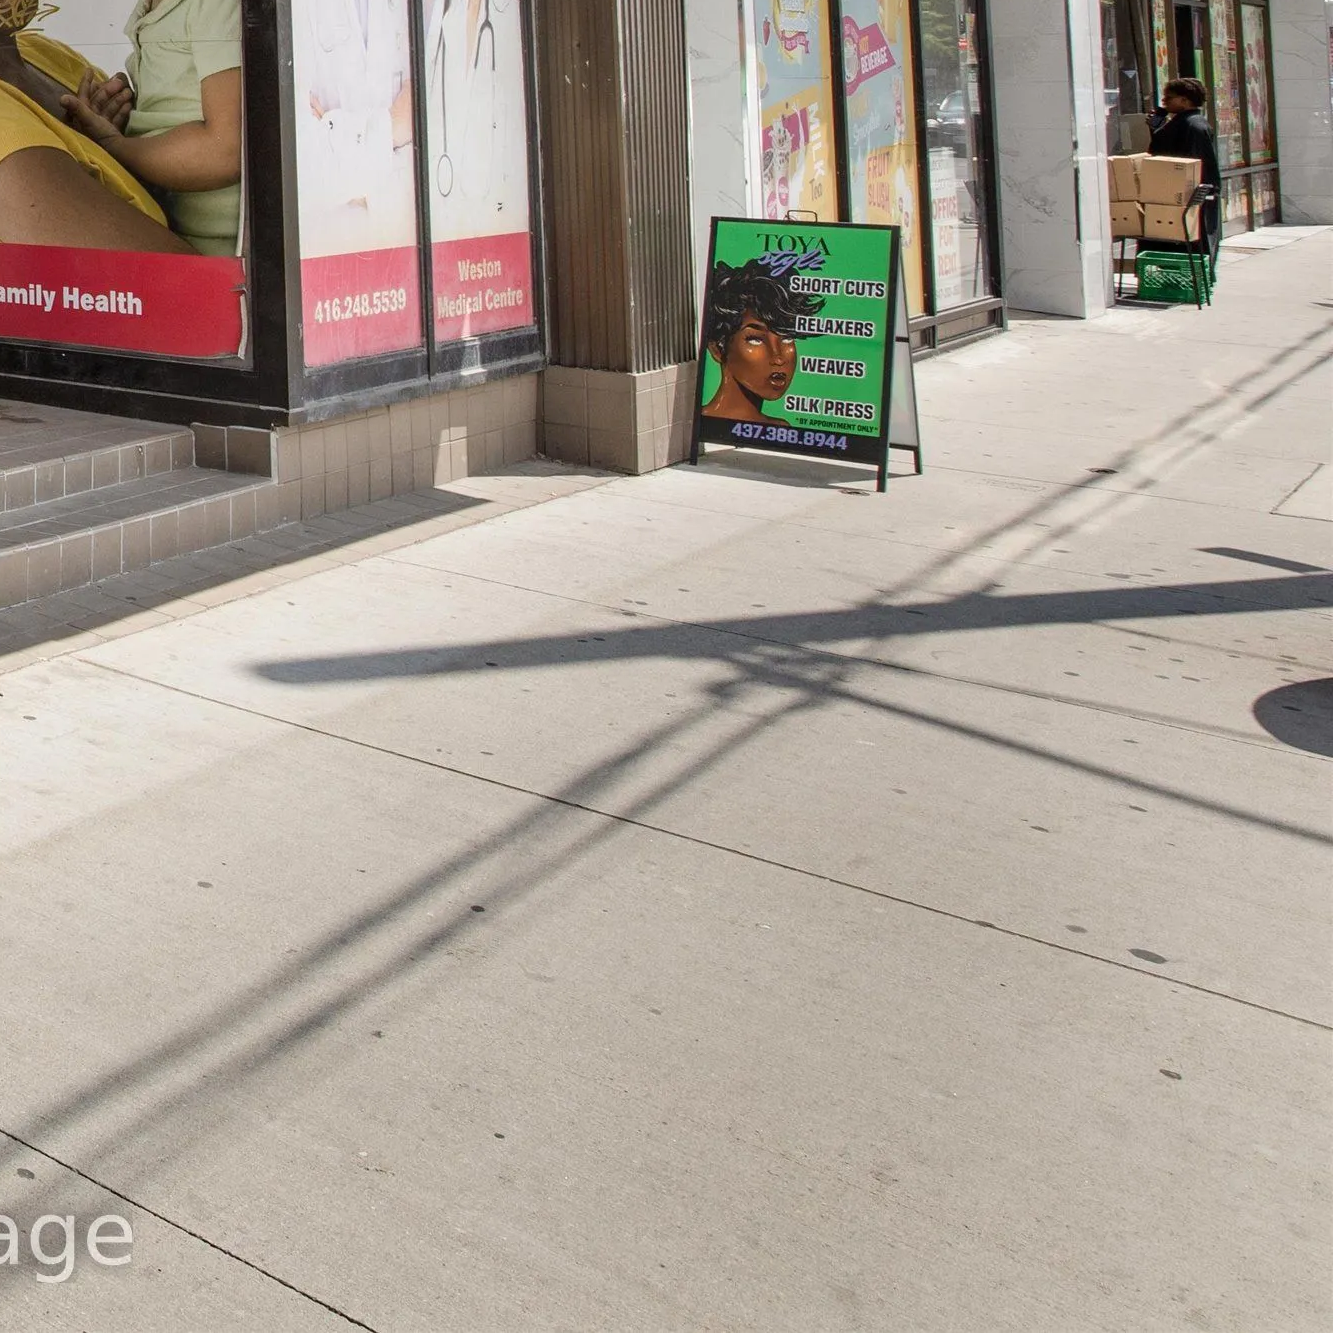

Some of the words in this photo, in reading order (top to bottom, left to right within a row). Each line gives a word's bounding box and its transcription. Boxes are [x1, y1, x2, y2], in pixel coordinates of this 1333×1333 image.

[867, 151, 891, 179] FRUIT
[757, 233, 832, 256] TOYA
[458, 258, 501, 282] Weston
[790, 276, 841, 295] SHORT
[845, 279, 885, 298] CUTS
[63, 286, 143, 315] Health
[314, 288, 406, 324] 416.248.5539
[437, 291, 483, 320] Medical
[485, 287, 523, 311] Centre
[795, 316, 874, 338] RELAXERS
[800, 356, 865, 378] WEAVES
[785, 395, 819, 414] SILK
[823, 400, 874, 421] PRESS
[732, 422, 848, 451] 437.388.8944
[809, 419, 856, 431] APPOINTMENT
